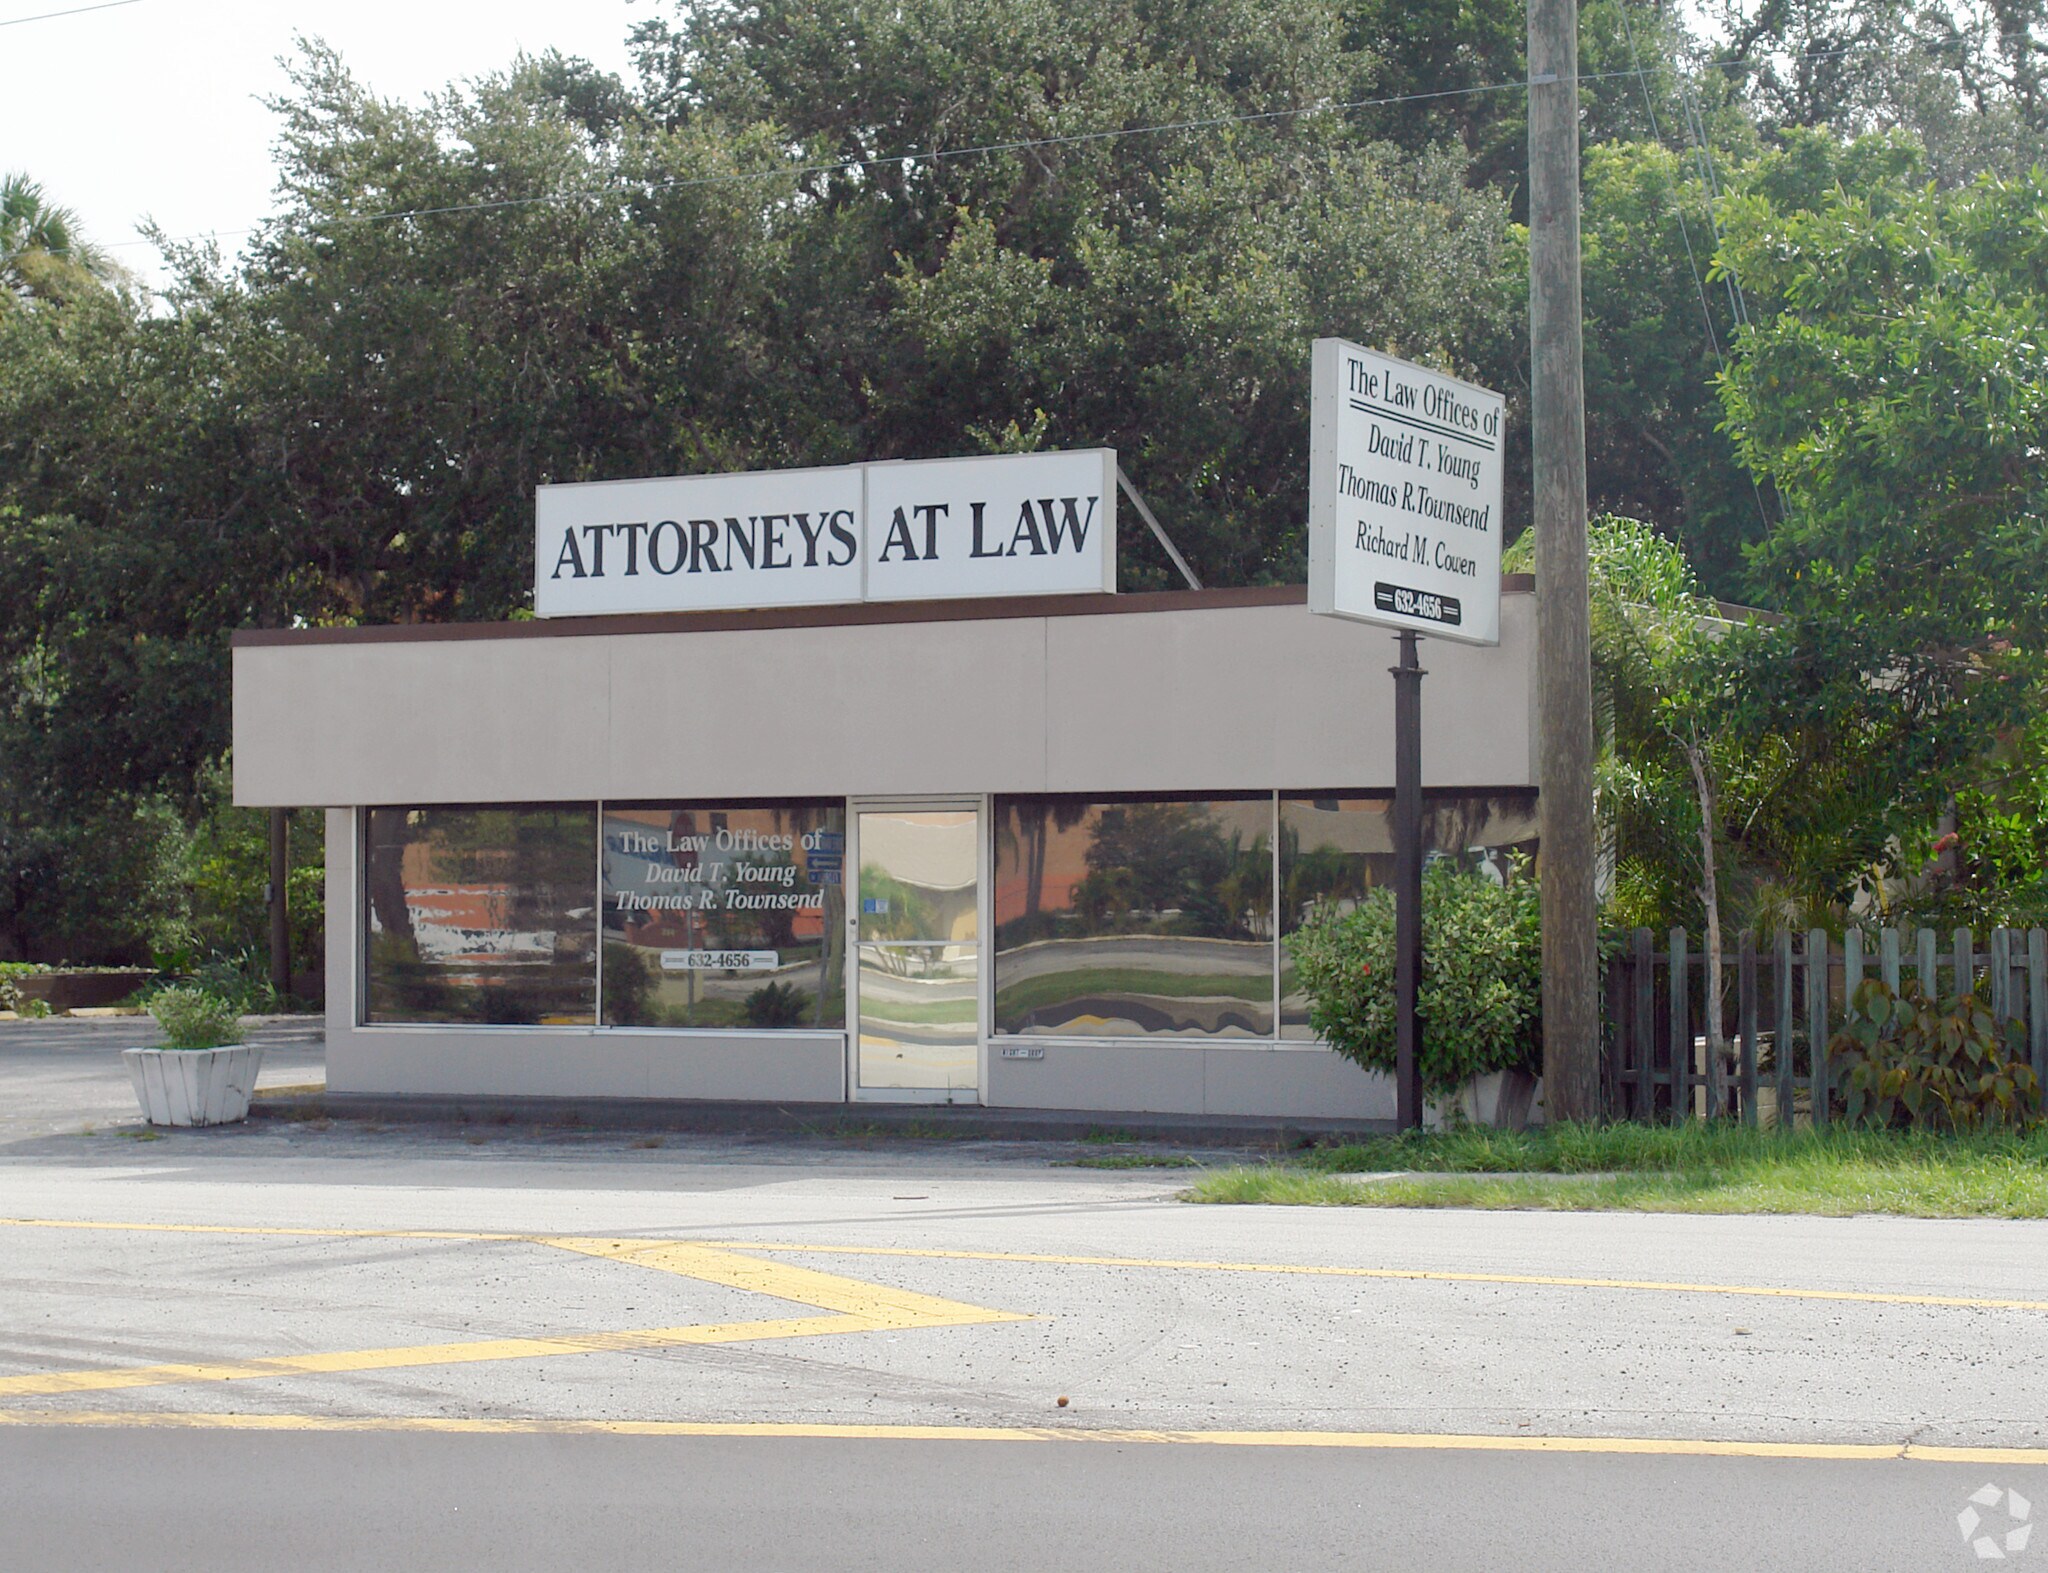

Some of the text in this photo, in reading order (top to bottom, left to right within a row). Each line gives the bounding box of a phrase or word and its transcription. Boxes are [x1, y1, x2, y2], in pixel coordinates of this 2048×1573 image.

[1347, 357, 1500, 438] The Law Offices of
[1367, 423, 1482, 490] David T. Young
[1338, 463, 1398, 507] Thomas
[551, 496, 1100, 579] ATTORNEYS AT LAW
[1355, 519, 1477, 578] Richard M. Cowen
[1394, 588, 1443, 619] 632-4656
[619, 828, 823, 853] The Law Offices of
[645, 862, 702, 883] David
[709, 862, 728, 882] T.
[735, 862, 796, 887] Young
[615, 888, 825, 910] Thomas R. Townsend
[687, 953, 751, 968] 632-4656
